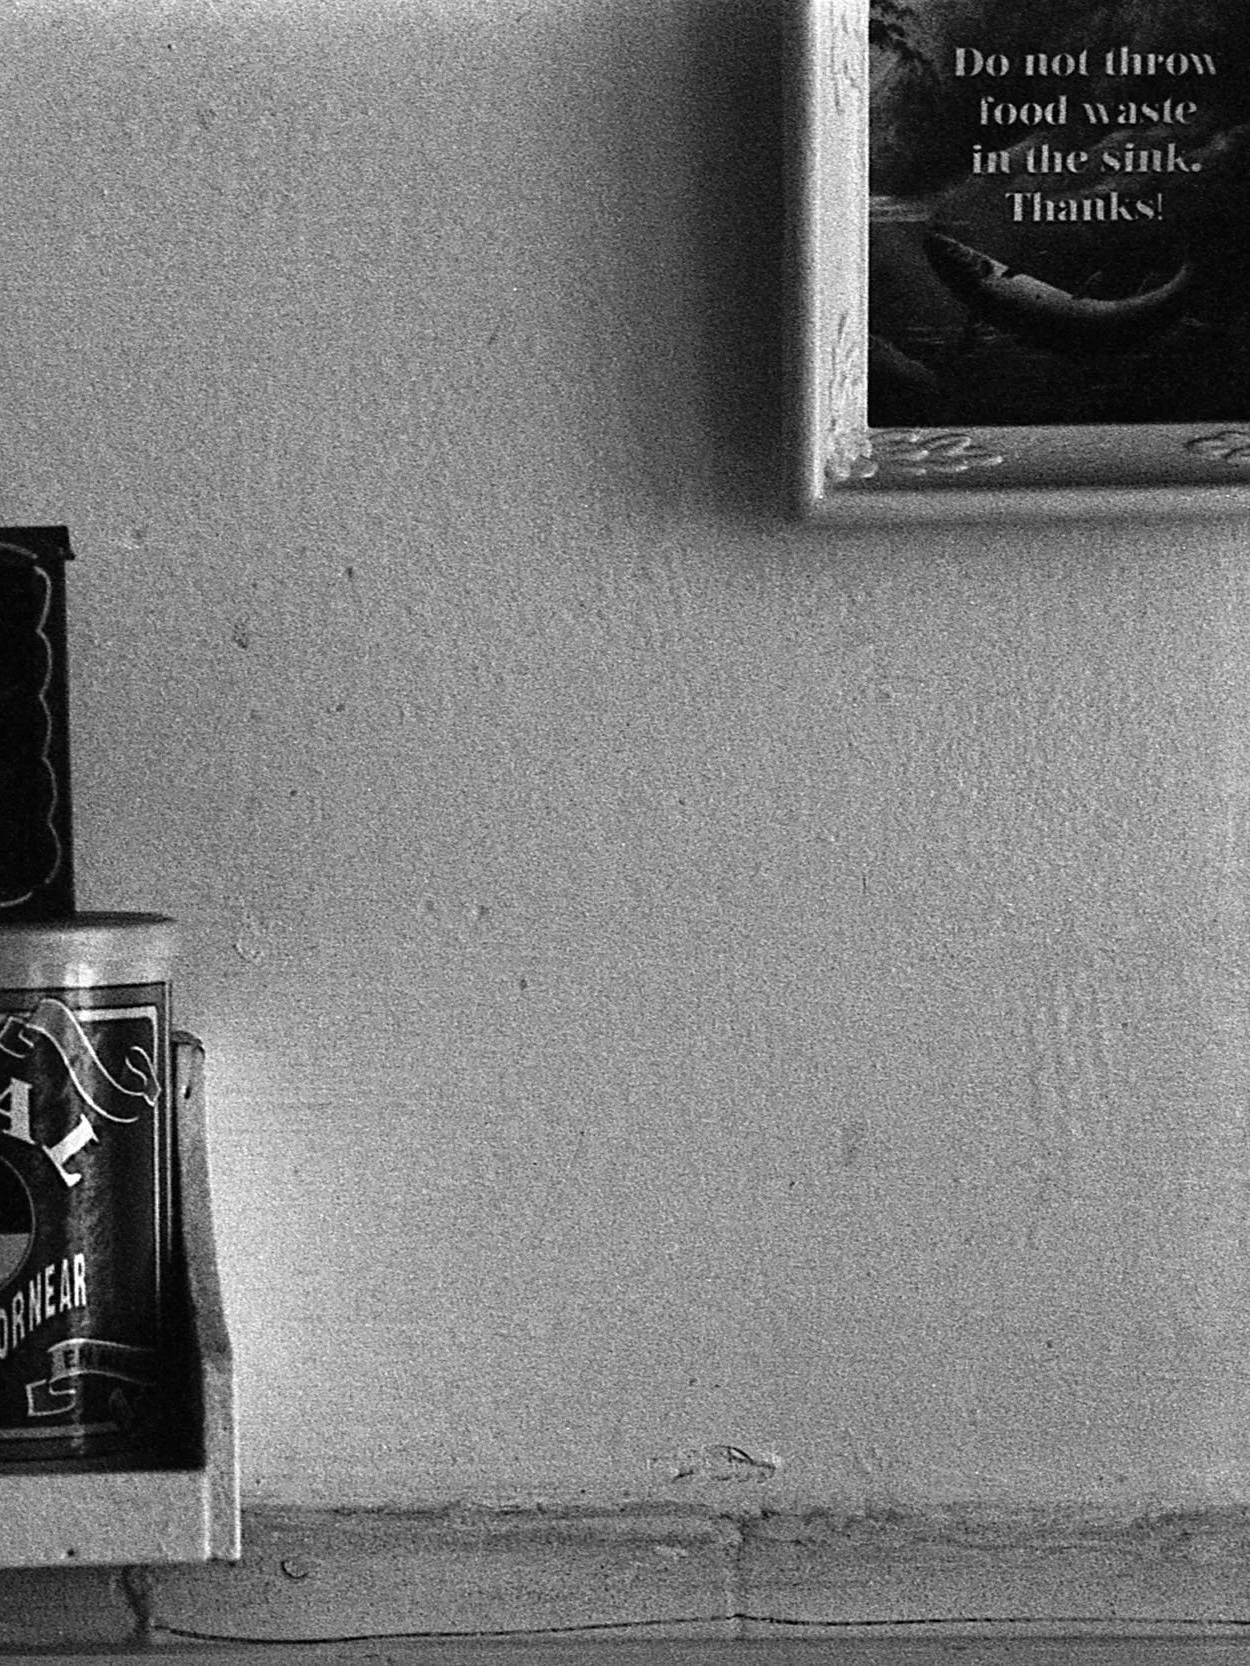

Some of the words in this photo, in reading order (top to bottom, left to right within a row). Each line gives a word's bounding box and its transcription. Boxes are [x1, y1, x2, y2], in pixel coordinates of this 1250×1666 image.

[955, 47, 1010, 77] Do
[1025, 49, 1089, 76] not
[1105, 46, 1217, 76] throw
[980, 95, 1067, 125] food
[1082, 98, 1198, 125] waste
[972, 144, 1011, 174] in
[1026, 143, 1089, 174] the
[1101, 142, 1202, 173] sink.
[1005, 191, 1163, 222] Thanks!
